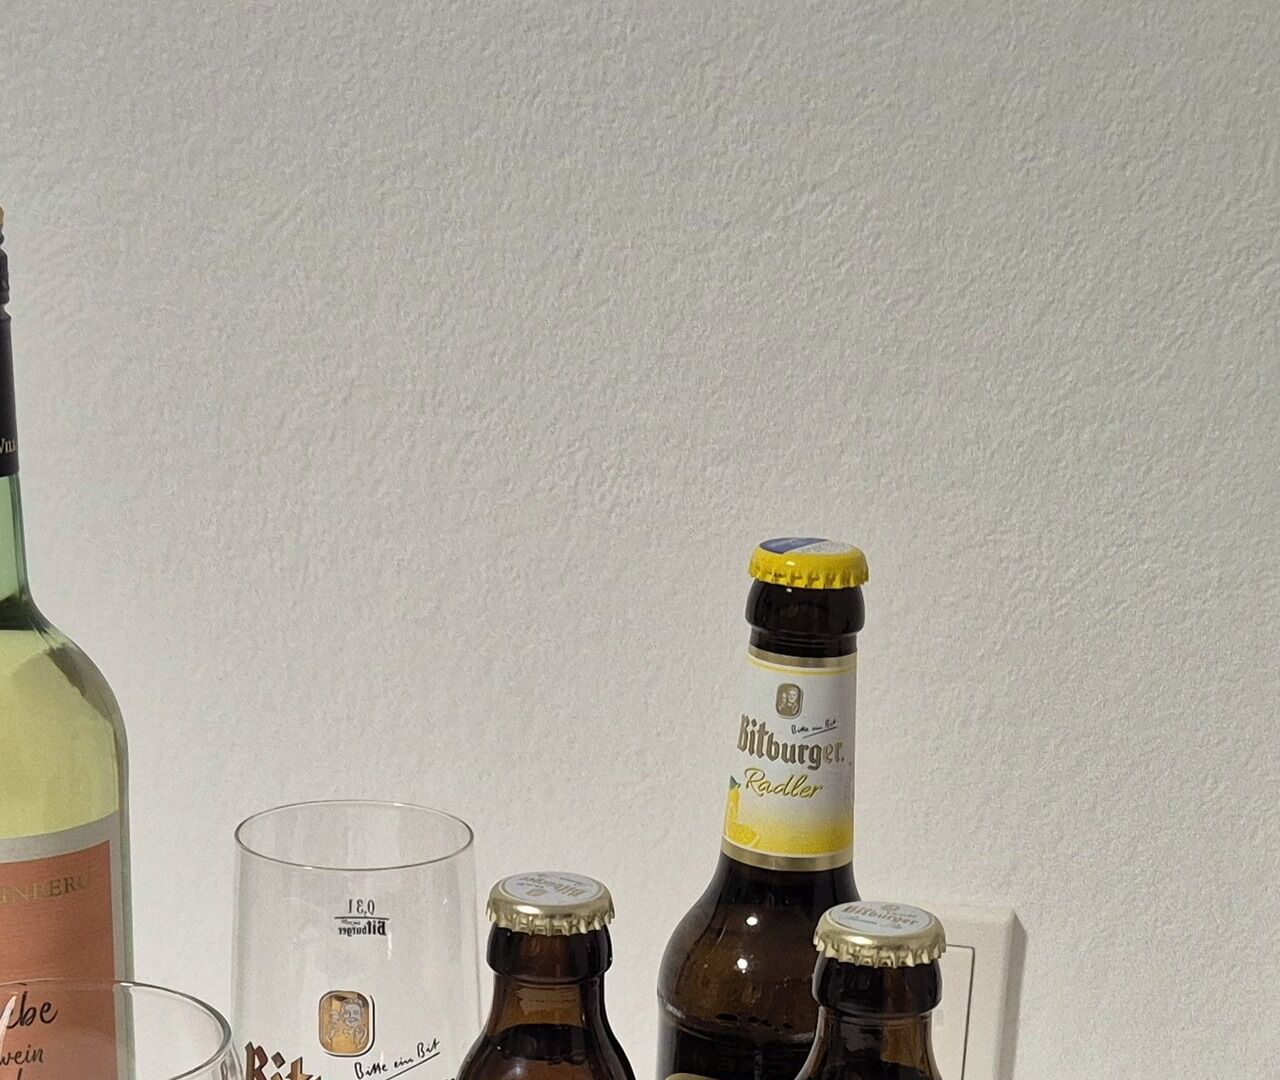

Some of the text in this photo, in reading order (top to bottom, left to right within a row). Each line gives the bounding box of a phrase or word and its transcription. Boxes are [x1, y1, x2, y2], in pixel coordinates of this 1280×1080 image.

[744, 767, 823, 798] Radler
[354, 1061, 388, 1080] Bitte
[417, 1037, 440, 1059] Bit
